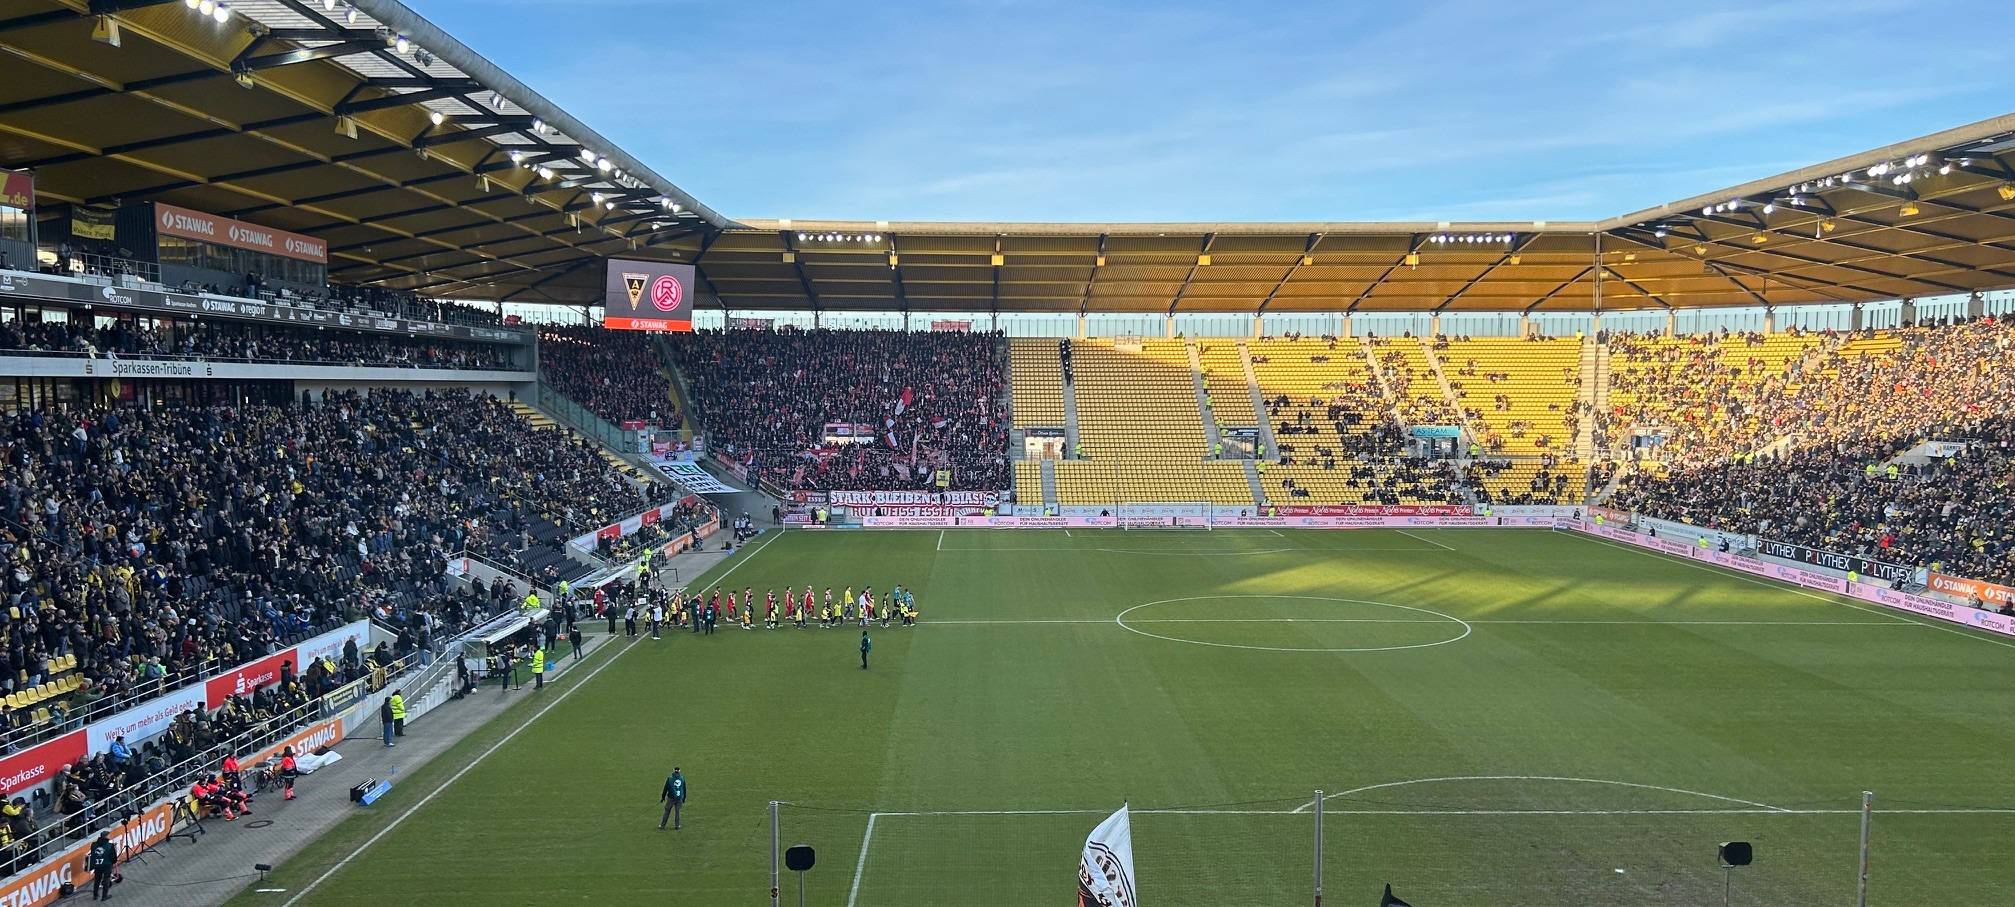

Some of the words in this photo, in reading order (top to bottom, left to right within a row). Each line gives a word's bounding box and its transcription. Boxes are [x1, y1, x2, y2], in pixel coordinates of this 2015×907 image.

[175, 215, 214, 236] STAWAG
[240, 228, 273, 248] STAWAG
[294, 240, 324, 258] STAWAG
[110, 294, 132, 304] ROTCOM
[210, 300, 236, 312] STAWAG
[640, 320, 668, 329] STAWAG
[112, 360, 191, 376] Sparkassen-Tribüne
[831, 492, 870, 504] STARK
[876, 492, 931, 504] BLEIBEN
[1757, 540, 1796, 558] POLYTHEX
[1806, 550, 1850, 570] POLYTHEX
[1861, 561, 1911, 584] POLYTHEX
[1944, 582, 1976, 594] STAWAG
[1982, 619, 2005, 630] ROTCOM
[247, 672, 272, 689] Sparkasse
[105, 726, 125, 742] Weil's
[126, 724, 137, 734] um
[138, 718, 151, 730] mehr
[152, 712, 164, 724] als
[164, 706, 178, 720] Geld
[297, 723, 336, 756] STAWAG
[0, 764, 45, 790] Sparkasse
[110, 812, 165, 857] TAWAG
